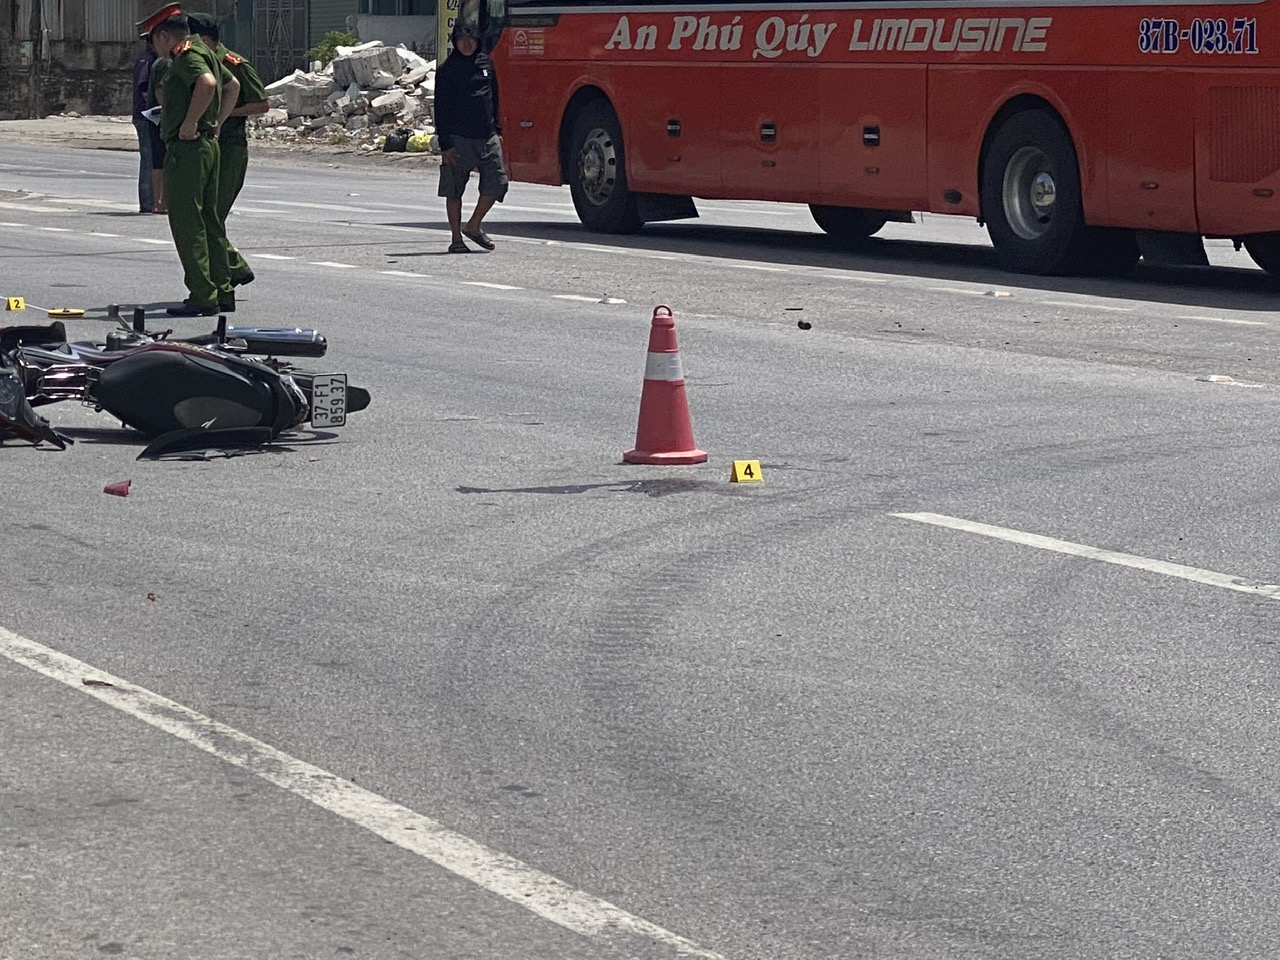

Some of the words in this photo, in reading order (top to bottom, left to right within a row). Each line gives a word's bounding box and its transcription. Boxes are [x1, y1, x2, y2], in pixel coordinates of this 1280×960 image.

[604, 15, 658, 50] An
[667, 15, 744, 51] Phú
[848, 17, 1053, 52] LIMOUSINE
[1138, 17, 1259, 54] 37B-023.71
[14, 299, 21, 308] 2
[314, 384, 329, 420] 37-F1
[330, 378, 345, 423] 859.37
[743, 463, 755, 479] 4
